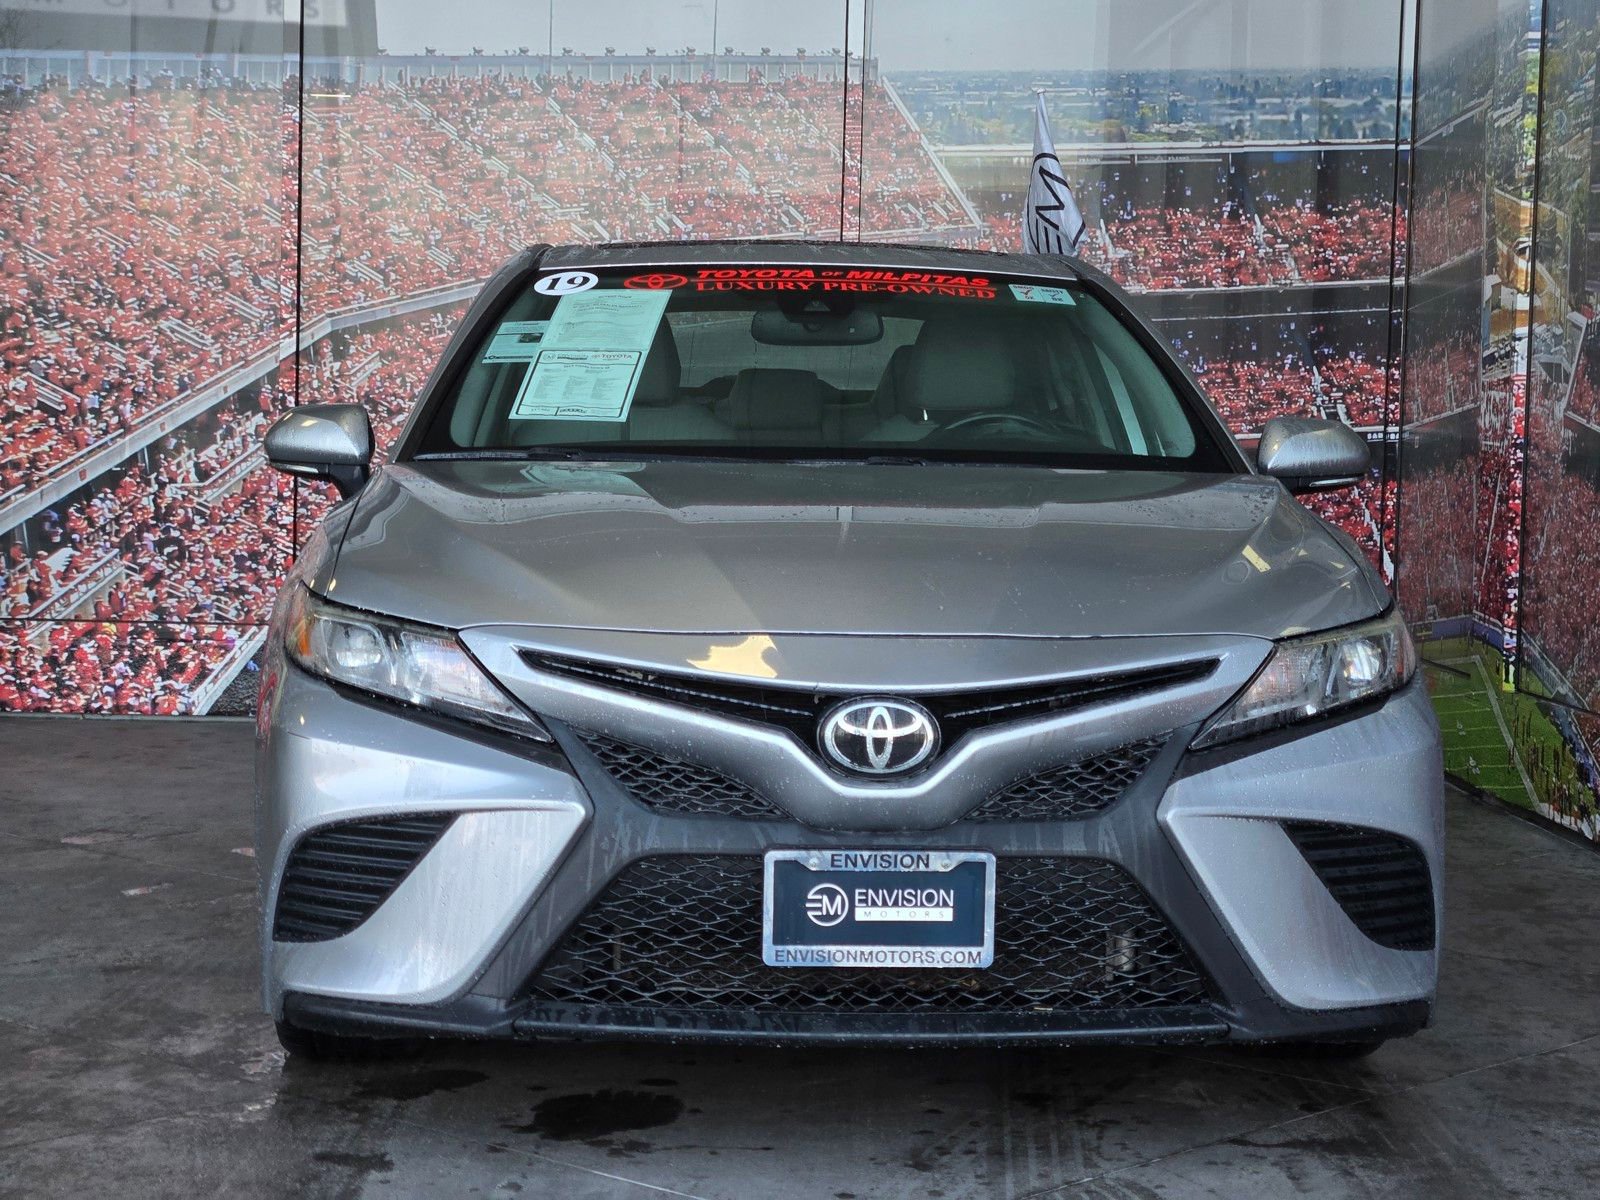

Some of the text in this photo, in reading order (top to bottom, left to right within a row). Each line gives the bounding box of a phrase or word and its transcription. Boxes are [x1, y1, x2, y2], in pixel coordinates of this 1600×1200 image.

[36, 0, 320, 19] ORS
[545, 275, 591, 290] 19
[697, 269, 815, 278] TOYOTA
[846, 270, 990, 287] MILPITAS
[696, 281, 996, 299] LUXURY PRE-OWNED
[830, 853, 931, 869] ENVISION
[854, 888, 954, 907] ENVISION
[863, 910, 945, 919] MOTORS
[774, 949, 982, 964] ENVISIONMOTORS.COM
